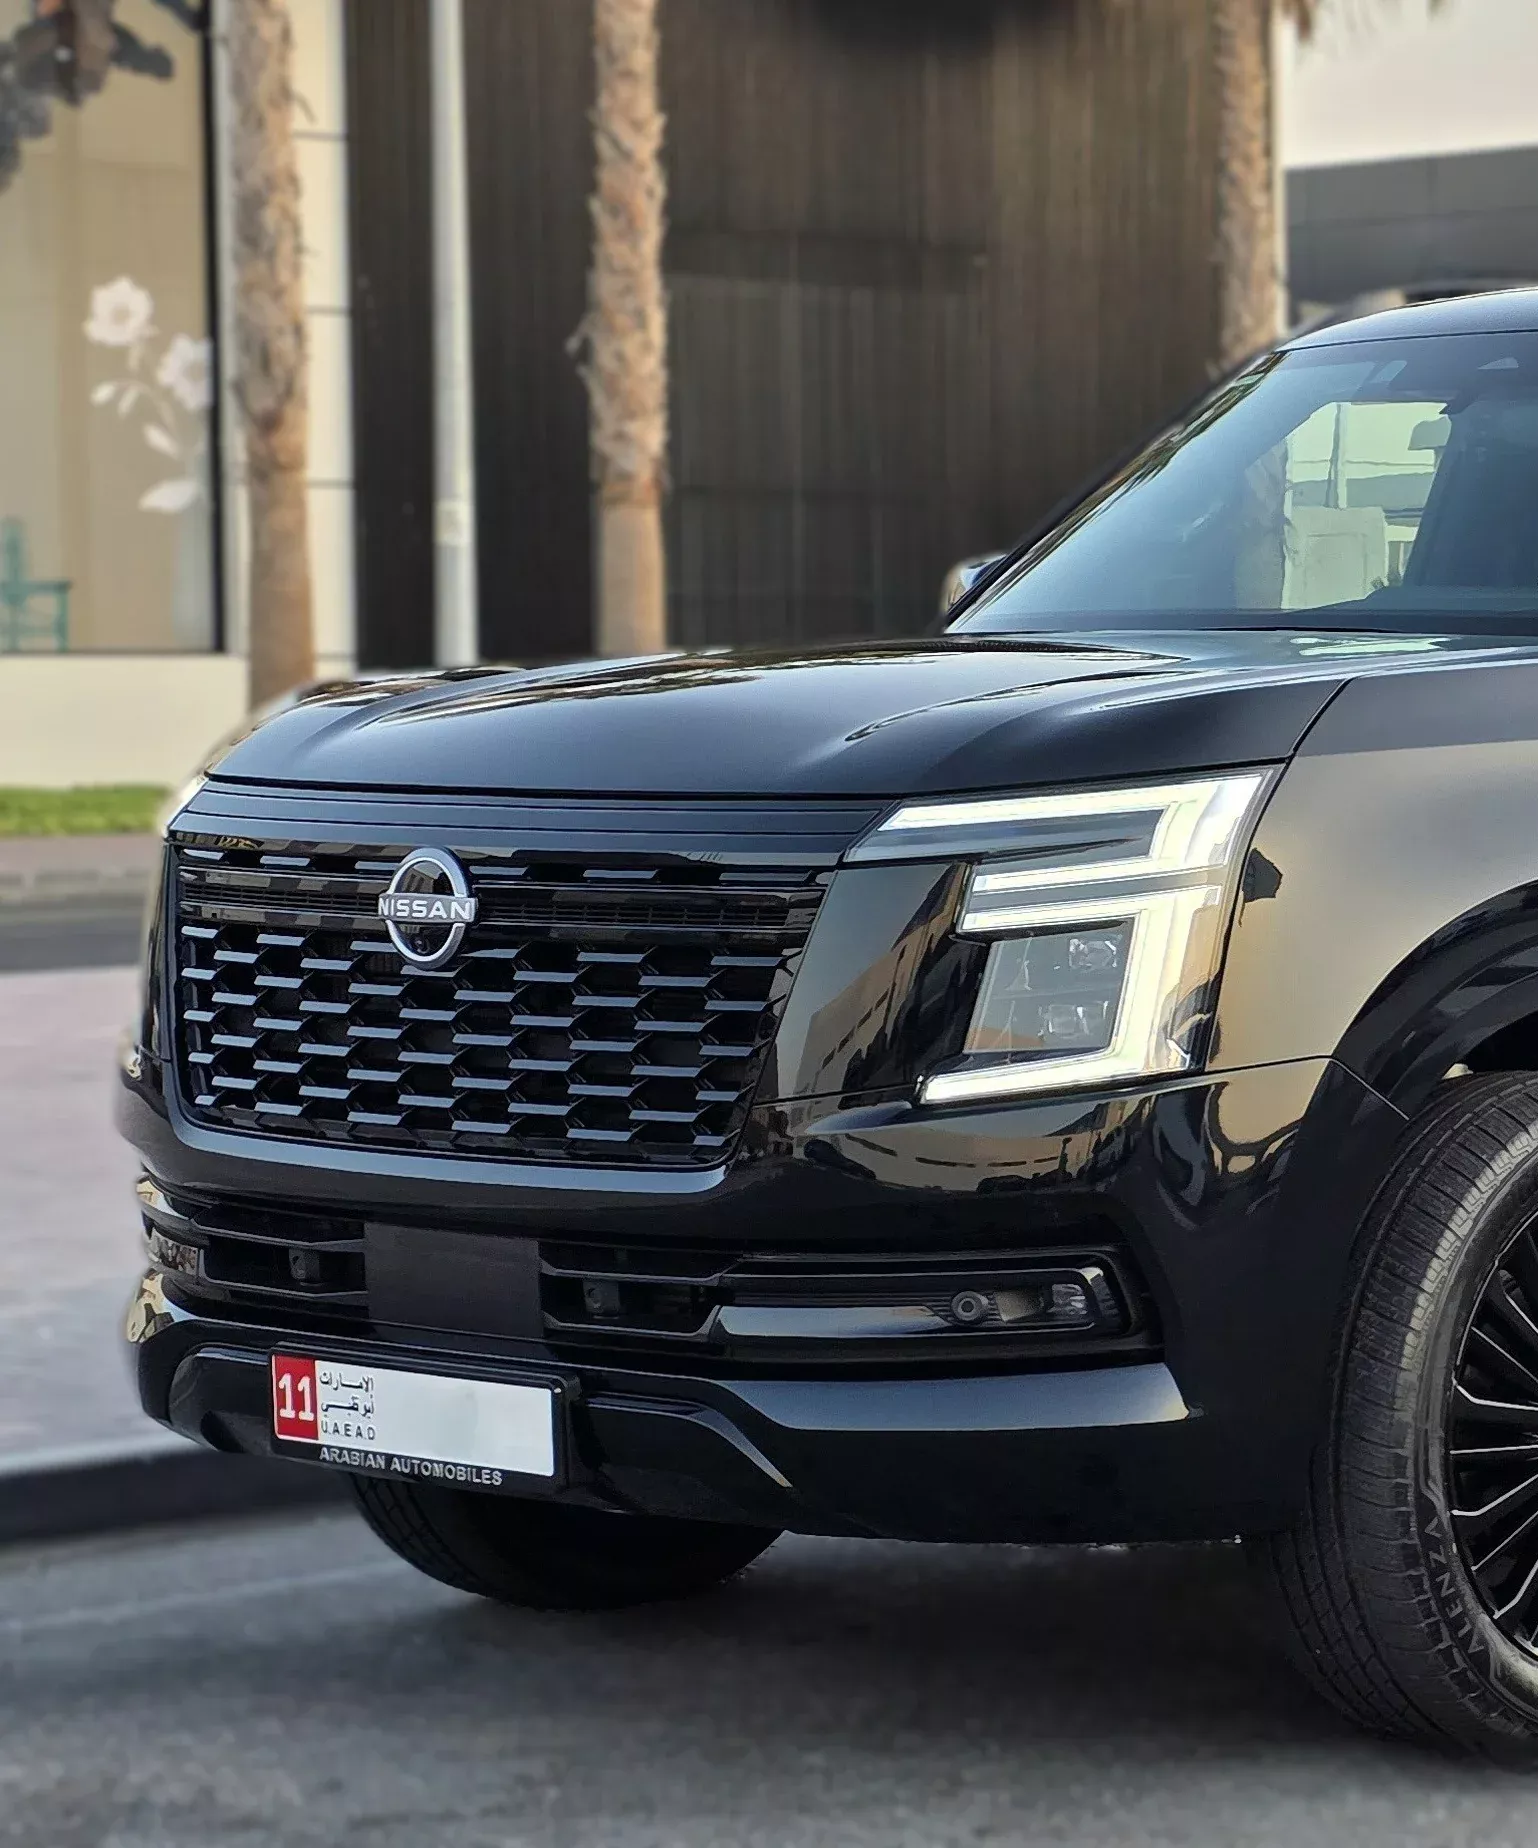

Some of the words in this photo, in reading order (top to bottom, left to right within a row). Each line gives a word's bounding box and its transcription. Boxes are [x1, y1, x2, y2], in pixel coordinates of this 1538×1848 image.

[378, 897, 472, 920] NISSAN
[278, 1372, 315, 1422] 11
[319, 1447, 386, 1471] ARABIAN
[390, 1458, 503, 1486] AUTOMOBILES
